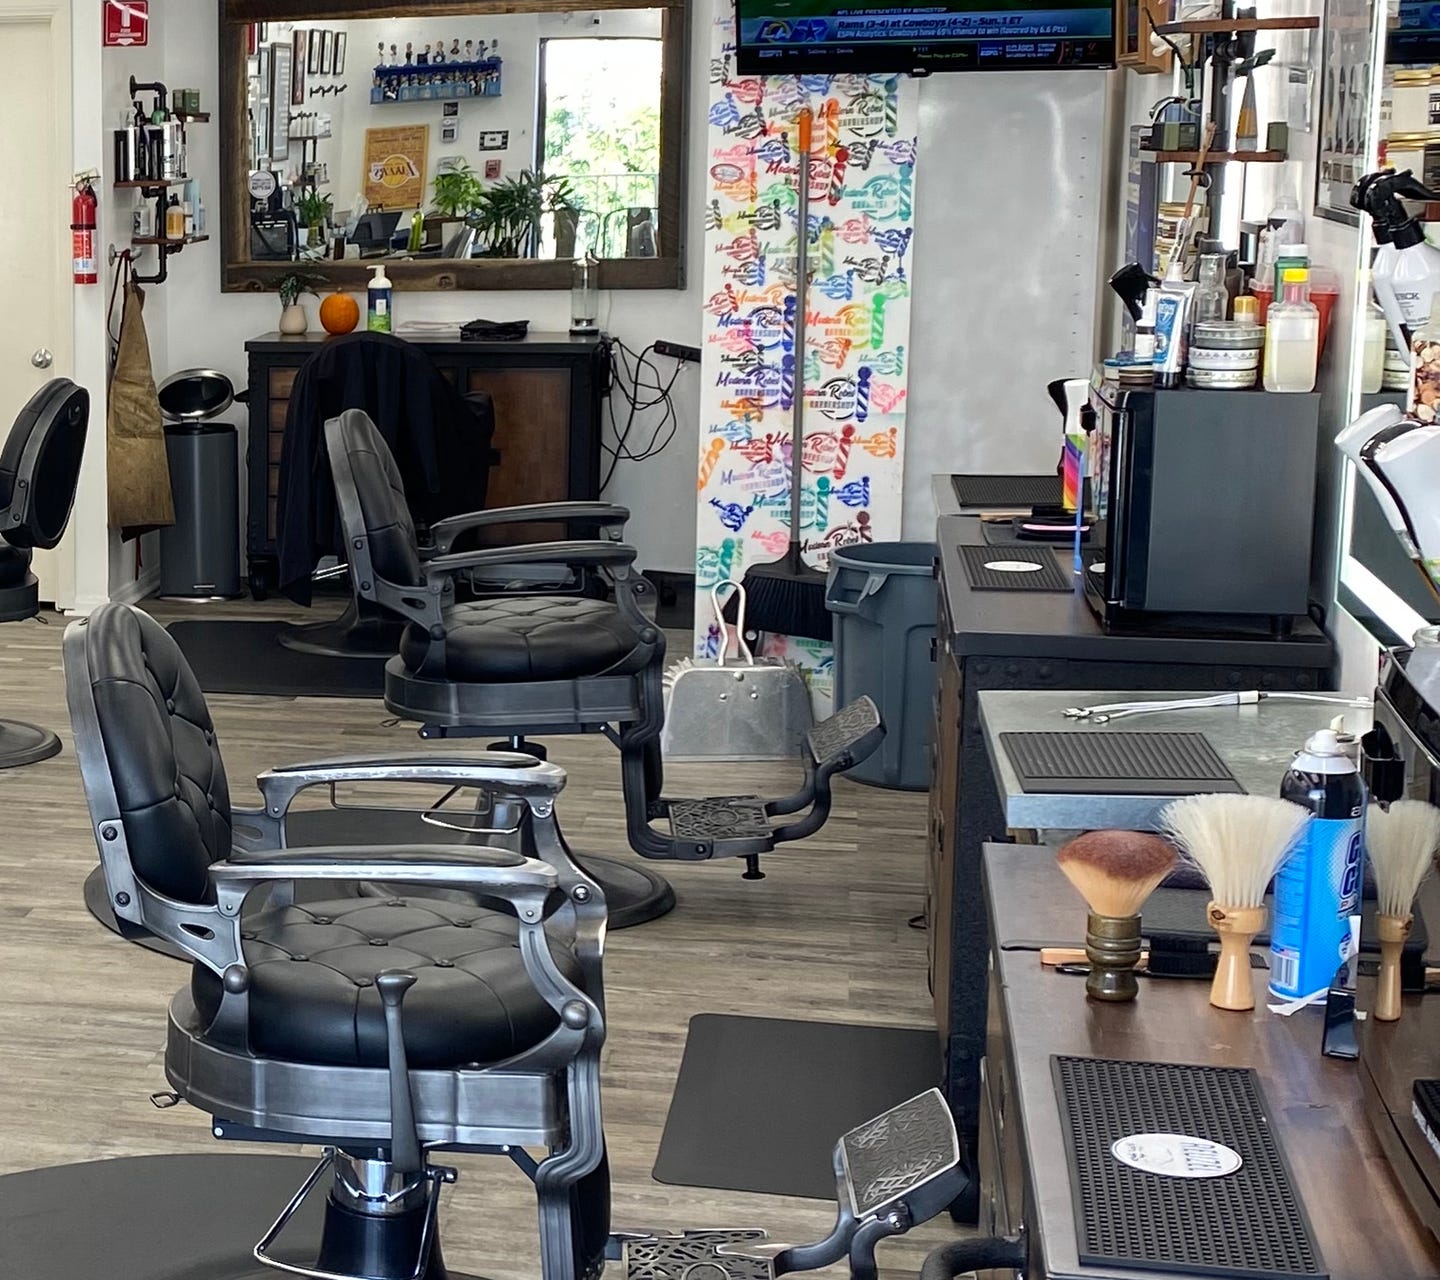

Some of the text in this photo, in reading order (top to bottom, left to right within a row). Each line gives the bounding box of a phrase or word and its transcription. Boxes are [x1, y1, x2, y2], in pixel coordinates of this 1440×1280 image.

[838, 20, 865, 30] Rams
[890, 19, 901, 28] at
[902, 17, 944, 30] Cowboys
[1009, 15, 1024, 25] ET
[889, 28, 919, 38] Cowboys
